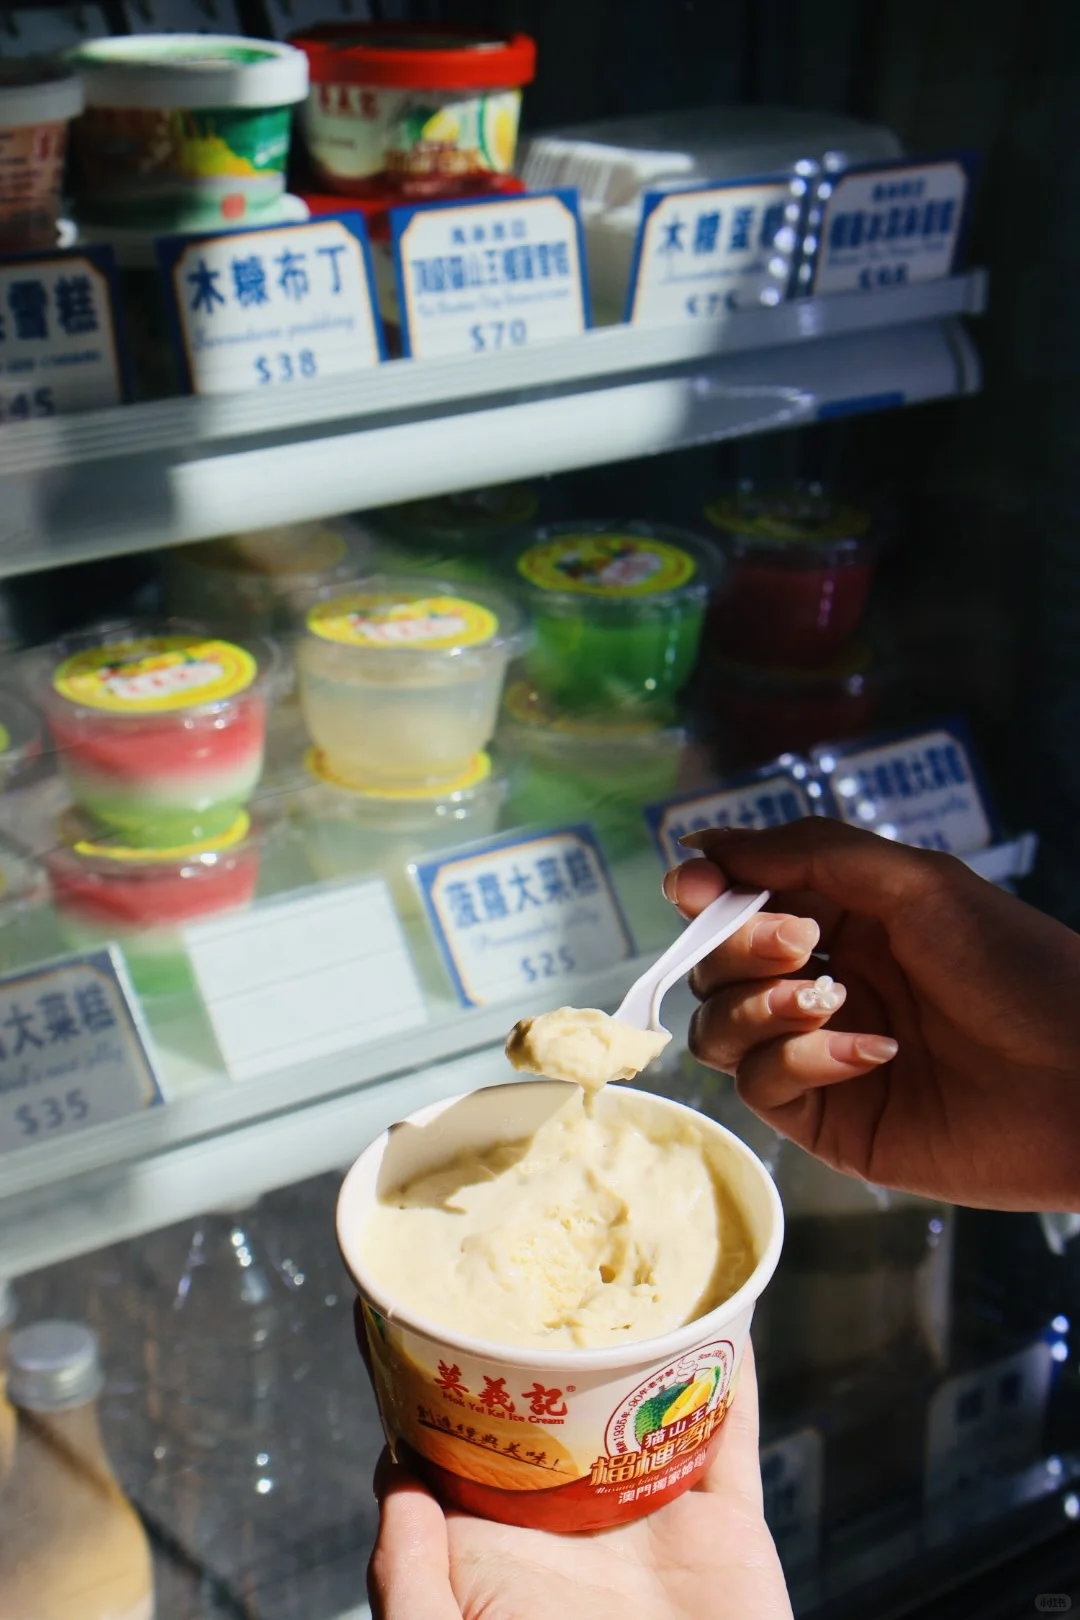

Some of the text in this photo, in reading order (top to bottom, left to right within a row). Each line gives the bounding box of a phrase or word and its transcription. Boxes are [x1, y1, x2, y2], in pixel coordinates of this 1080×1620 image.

[186, 245, 347, 315] 木糠布丁
[469, 315, 528, 353] $70
[254, 348, 317, 385] $38
[0, 387, 55, 422] 45
[520, 945, 575, 984] $25
[0, 982, 117, 1063] 大菜糕
[14, 1087, 90, 1137] $35
[433, 1359, 568, 1417] 莫義記
[508, 1412, 525, 1423] Ice
[528, 1415, 565, 1425] Cream
